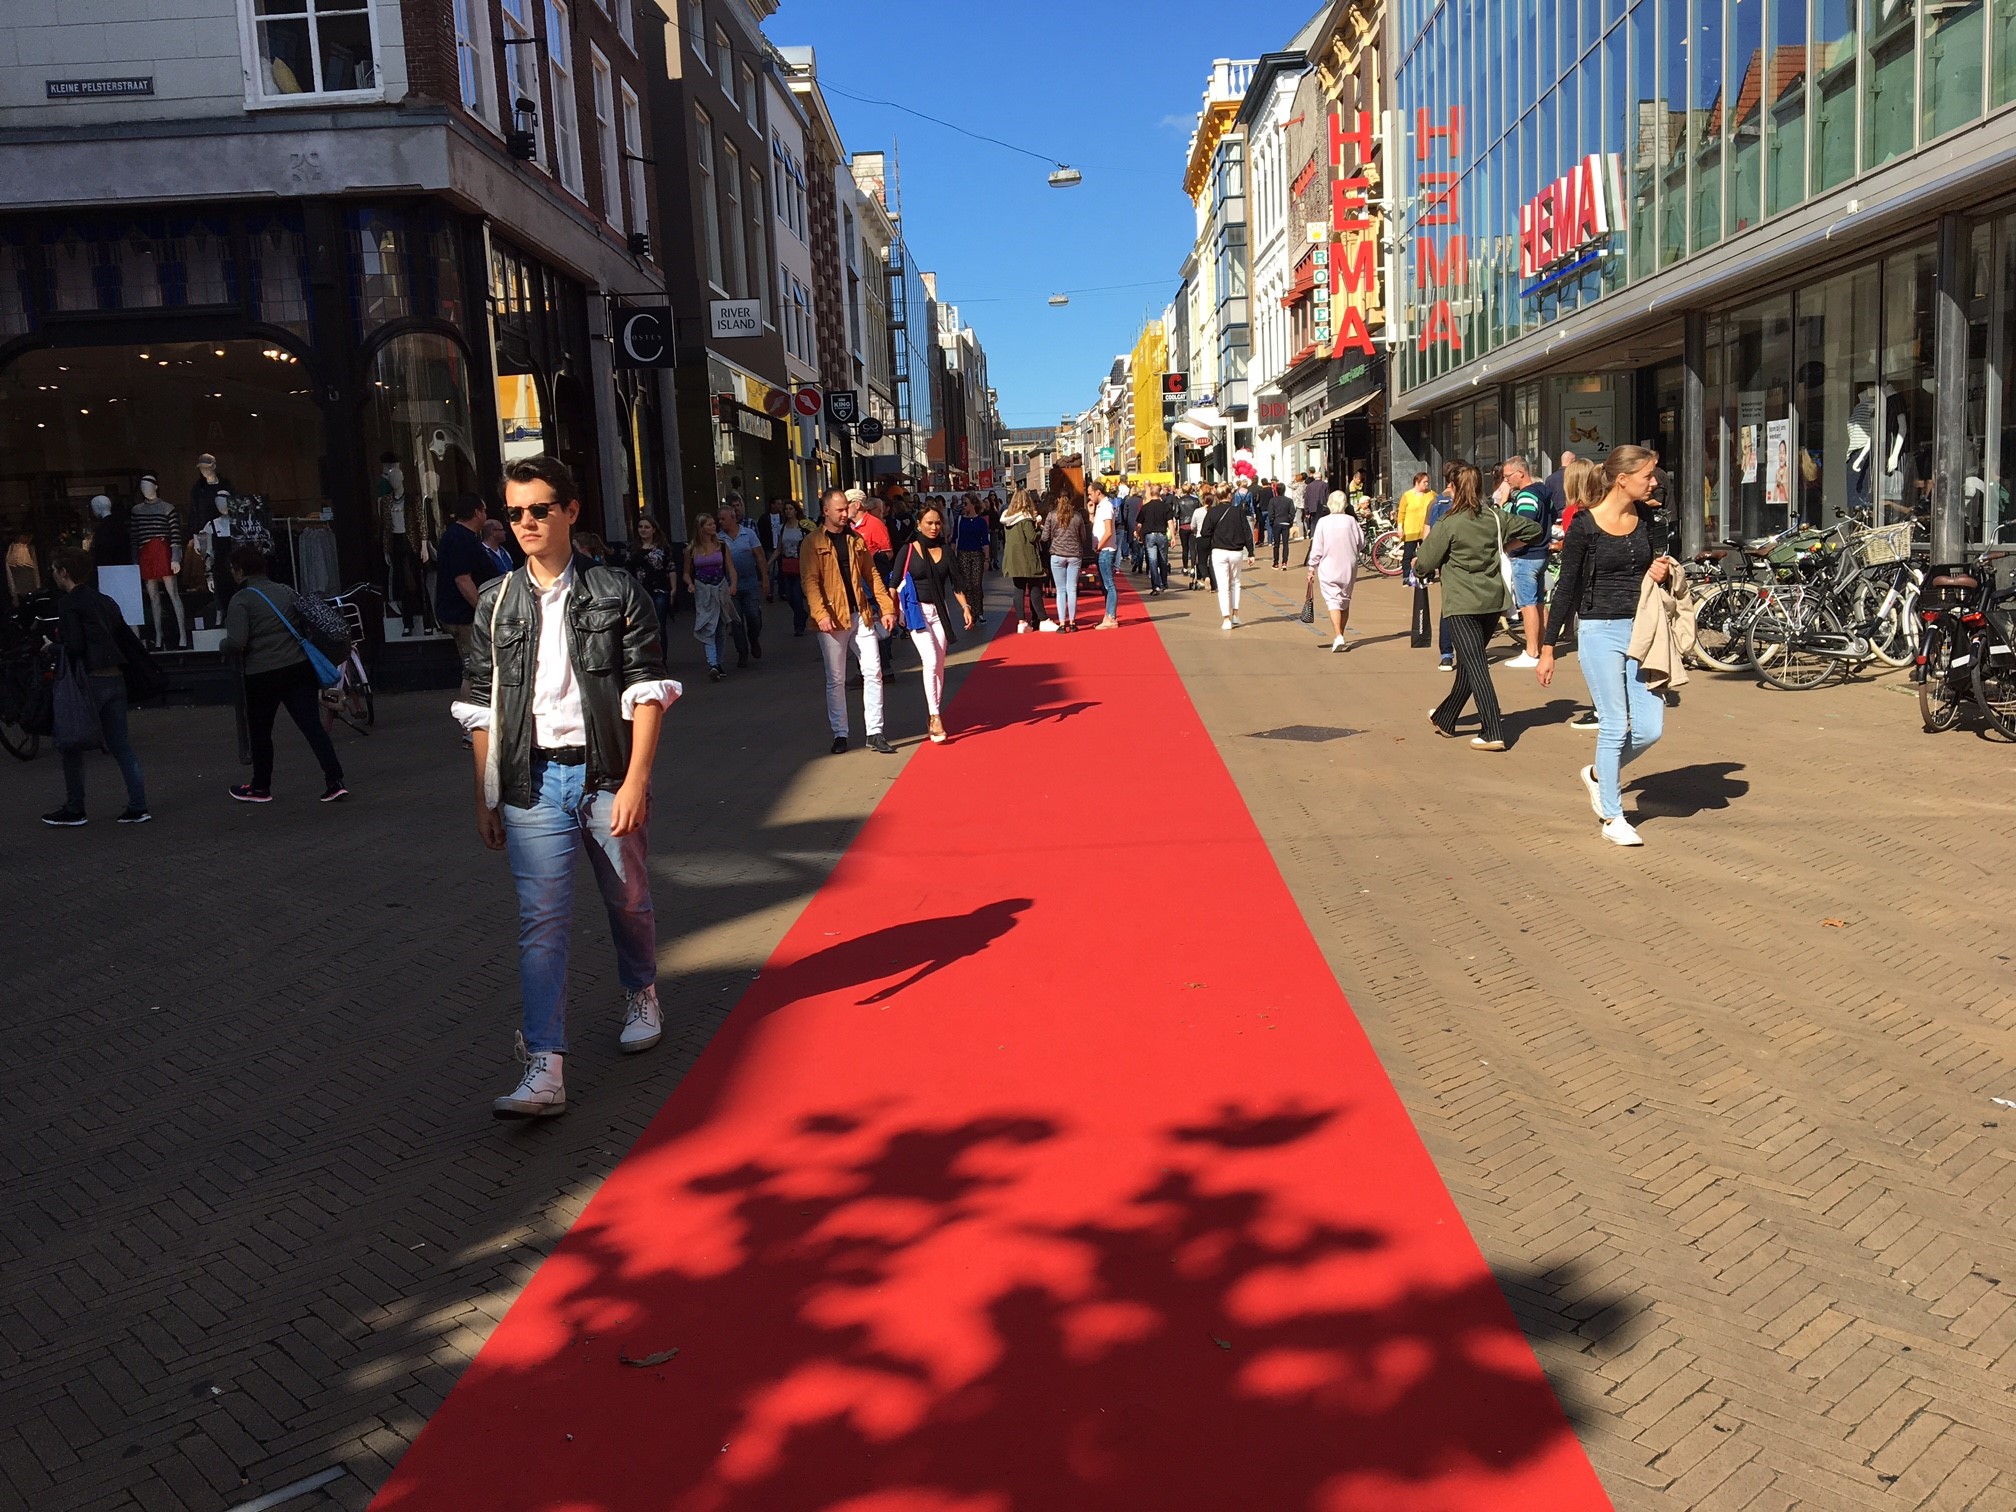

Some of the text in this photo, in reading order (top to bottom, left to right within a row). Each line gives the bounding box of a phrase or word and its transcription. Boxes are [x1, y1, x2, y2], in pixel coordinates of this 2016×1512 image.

[50, 80, 148, 93] KLEINE PELSTERSTRAAT
[1519, 154, 1608, 279] HEMA
[1328, 111, 1375, 359] HEMA
[1315, 252, 1329, 340] ROLEX
[720, 307, 751, 318] RIVER
[717, 319, 756, 330] ISLAND
[1165, 393, 1186, 401] COOLCAT
[1261, 402, 1287, 417] DIDI
